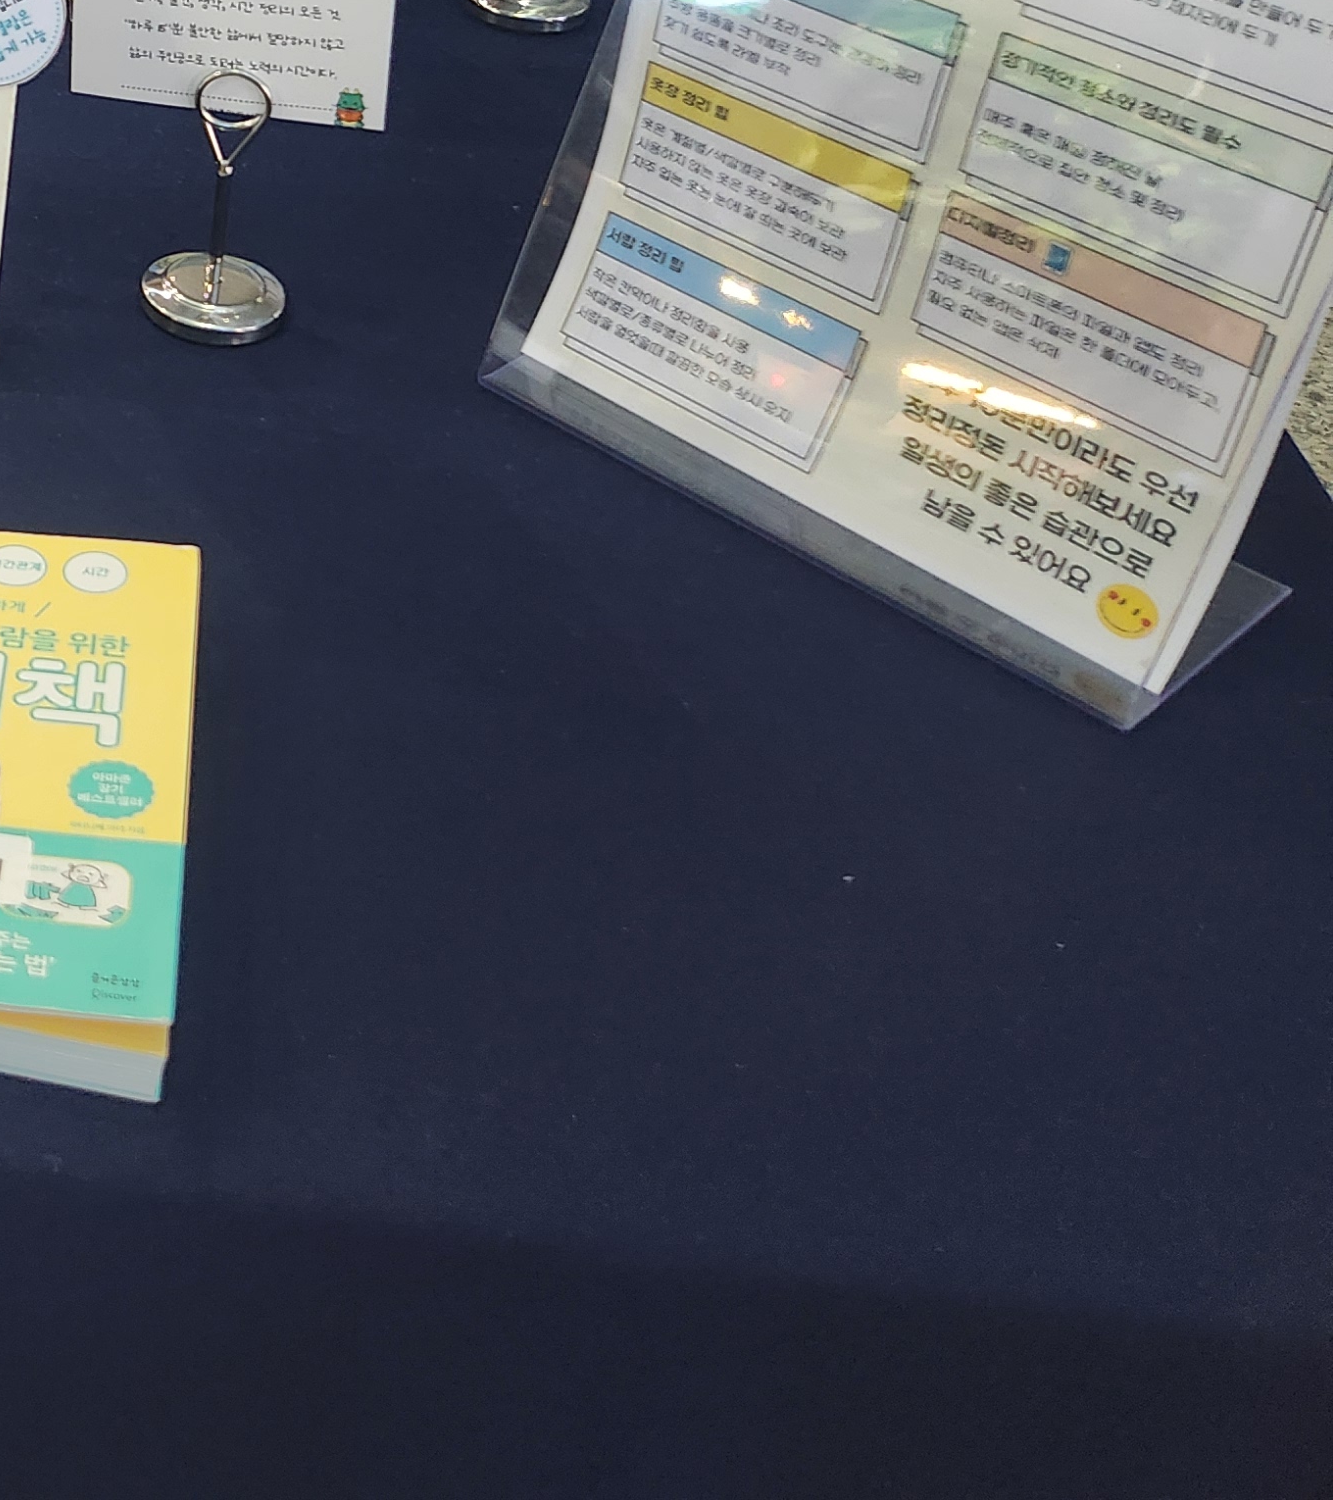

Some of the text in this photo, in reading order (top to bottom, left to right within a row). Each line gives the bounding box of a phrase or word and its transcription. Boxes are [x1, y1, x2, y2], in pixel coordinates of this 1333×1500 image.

[983, 476, 1039, 521] 좋은
[1041, 508, 1155, 579] 습관으로
[1008, 449, 1177, 548] 시작해보세요
[82, 564, 110, 580] 시간
[921, 488, 1092, 593] 남을 수 있어요
[67, 630, 130, 659] 위한
[24, 952, 56, 976] 법'
